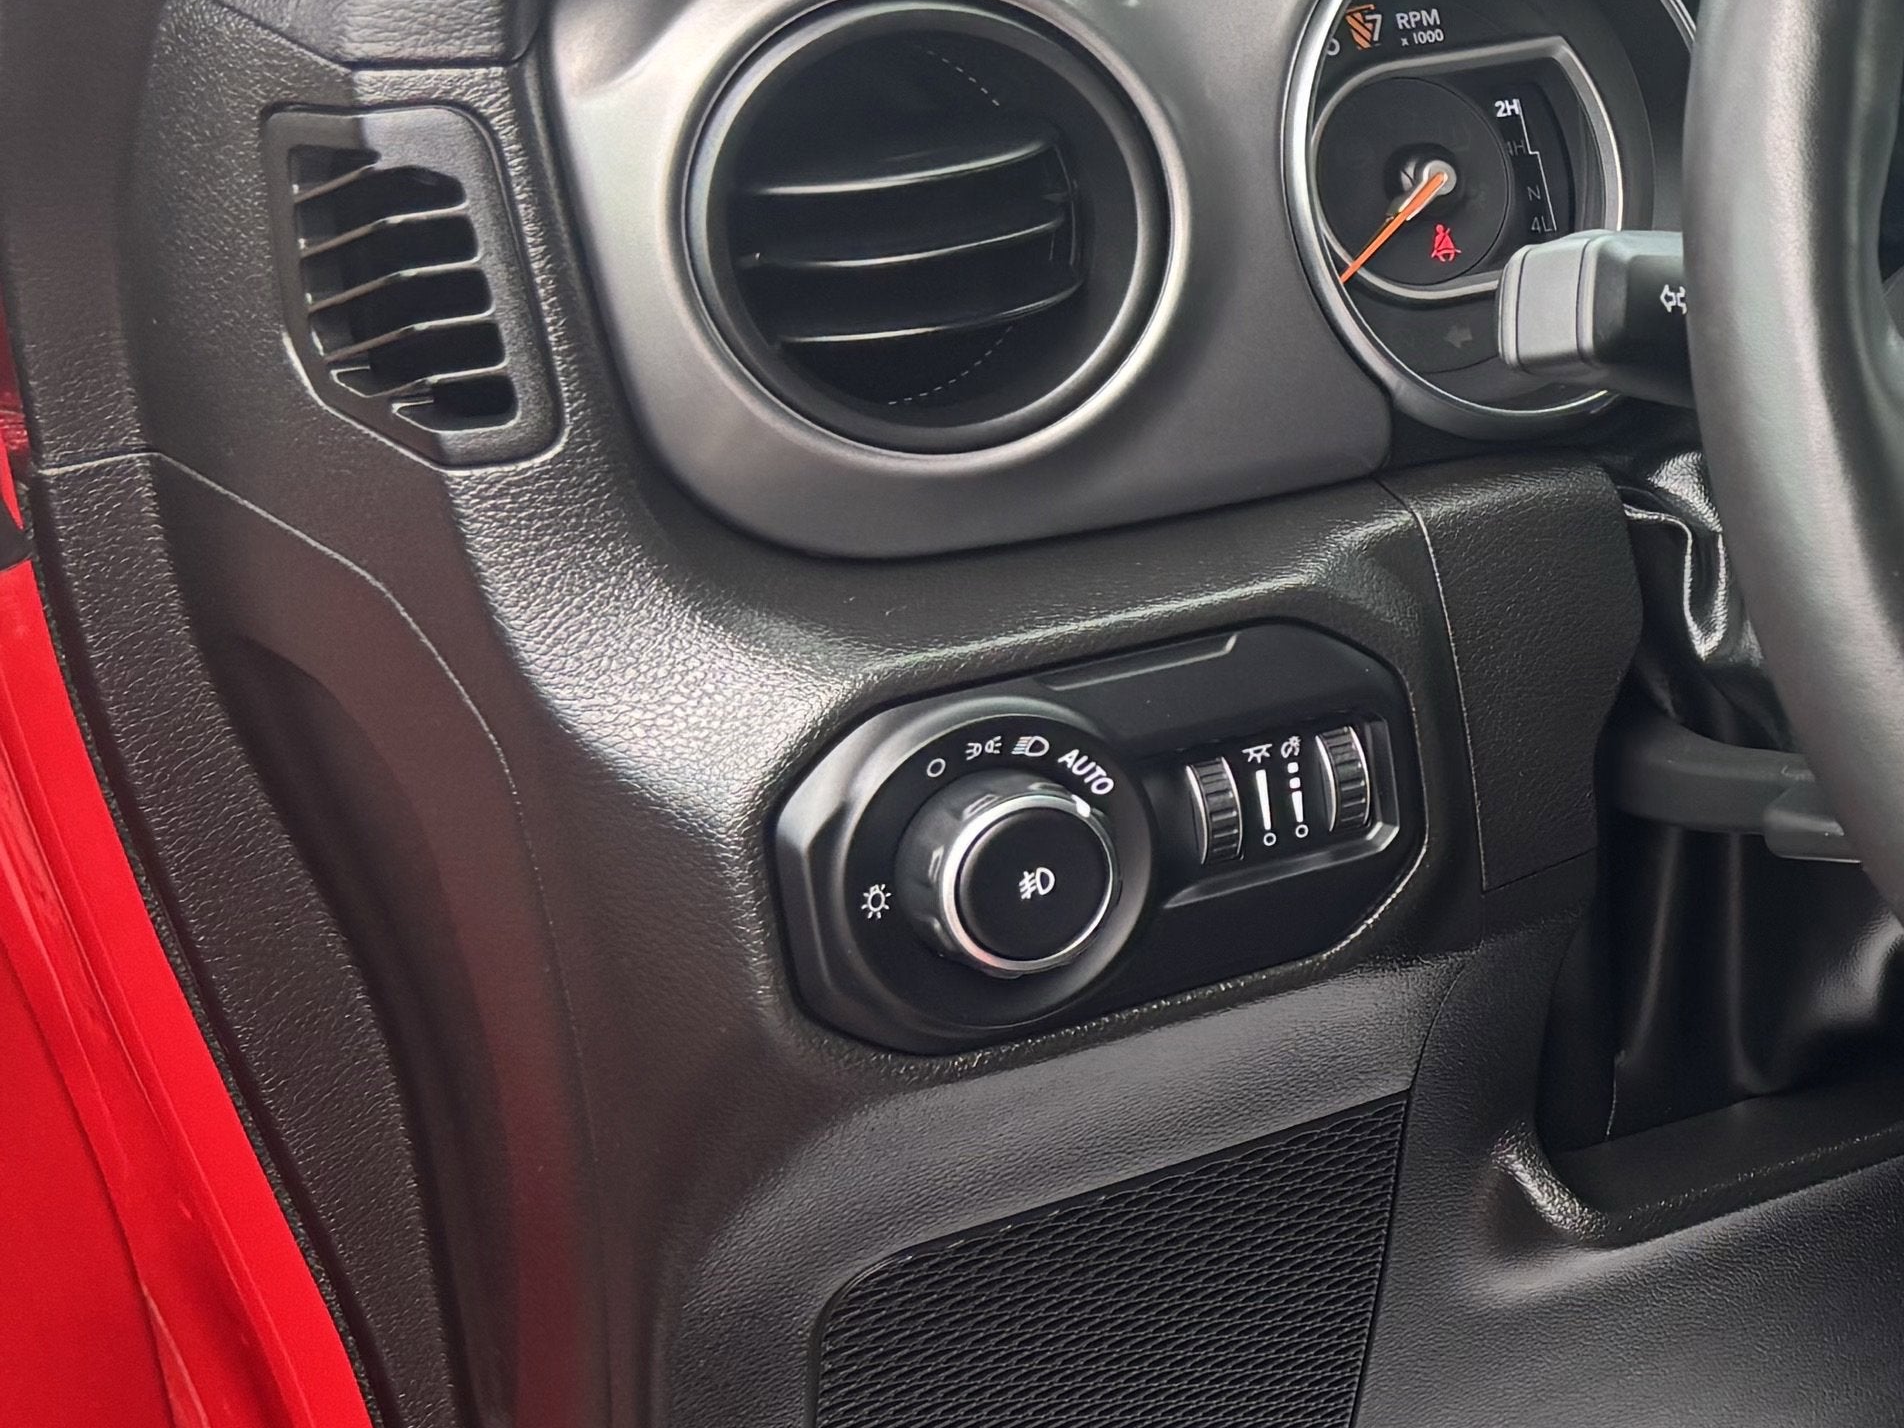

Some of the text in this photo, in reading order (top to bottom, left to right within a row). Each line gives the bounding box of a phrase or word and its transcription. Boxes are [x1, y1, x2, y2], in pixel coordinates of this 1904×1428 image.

[1396, 8, 1441, 30] RPM
[1412, 29, 1445, 45] 1000
[1495, 98, 1521, 118] 2H
[1057, 749, 1114, 795] AUTO
